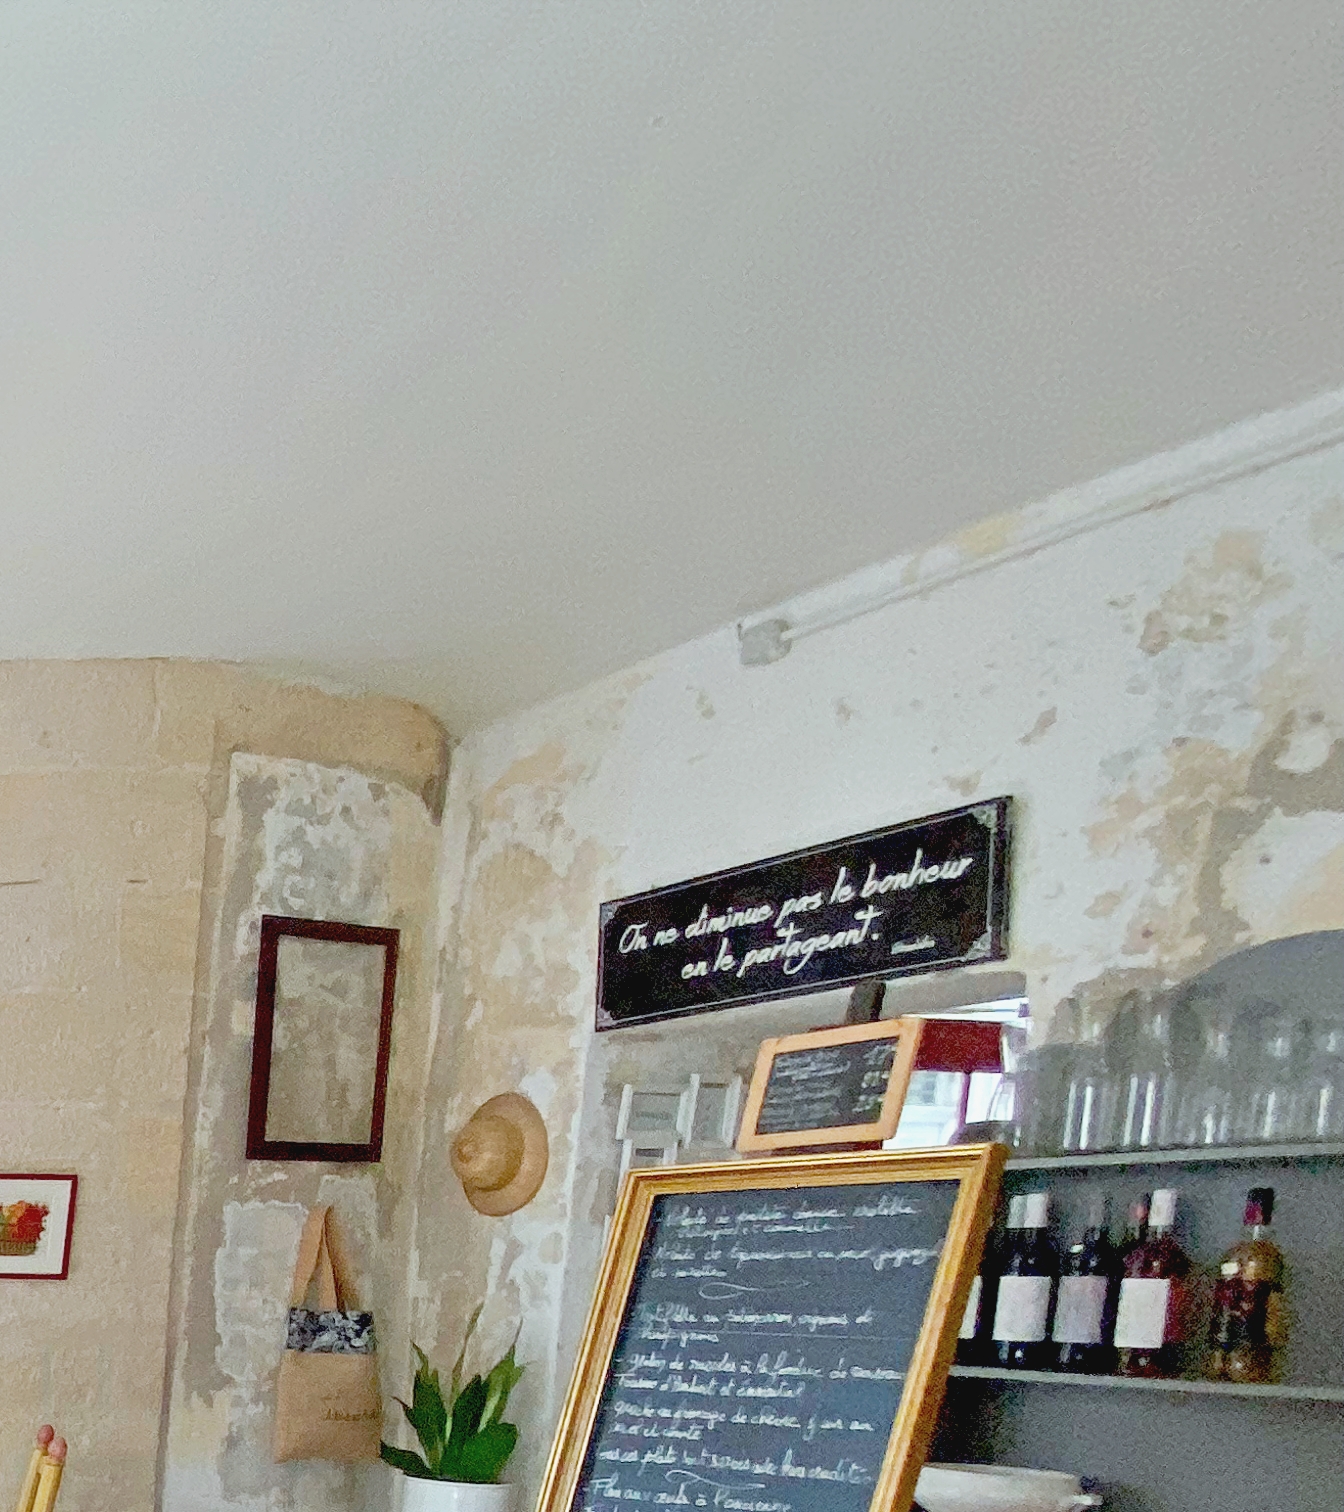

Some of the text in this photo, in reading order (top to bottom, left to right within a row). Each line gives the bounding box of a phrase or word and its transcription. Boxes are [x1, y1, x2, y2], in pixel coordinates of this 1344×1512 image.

[619, 847, 974, 954] On ne diminue pas le bonheur
[681, 959, 708, 980] en
[713, 938, 736, 972] le
